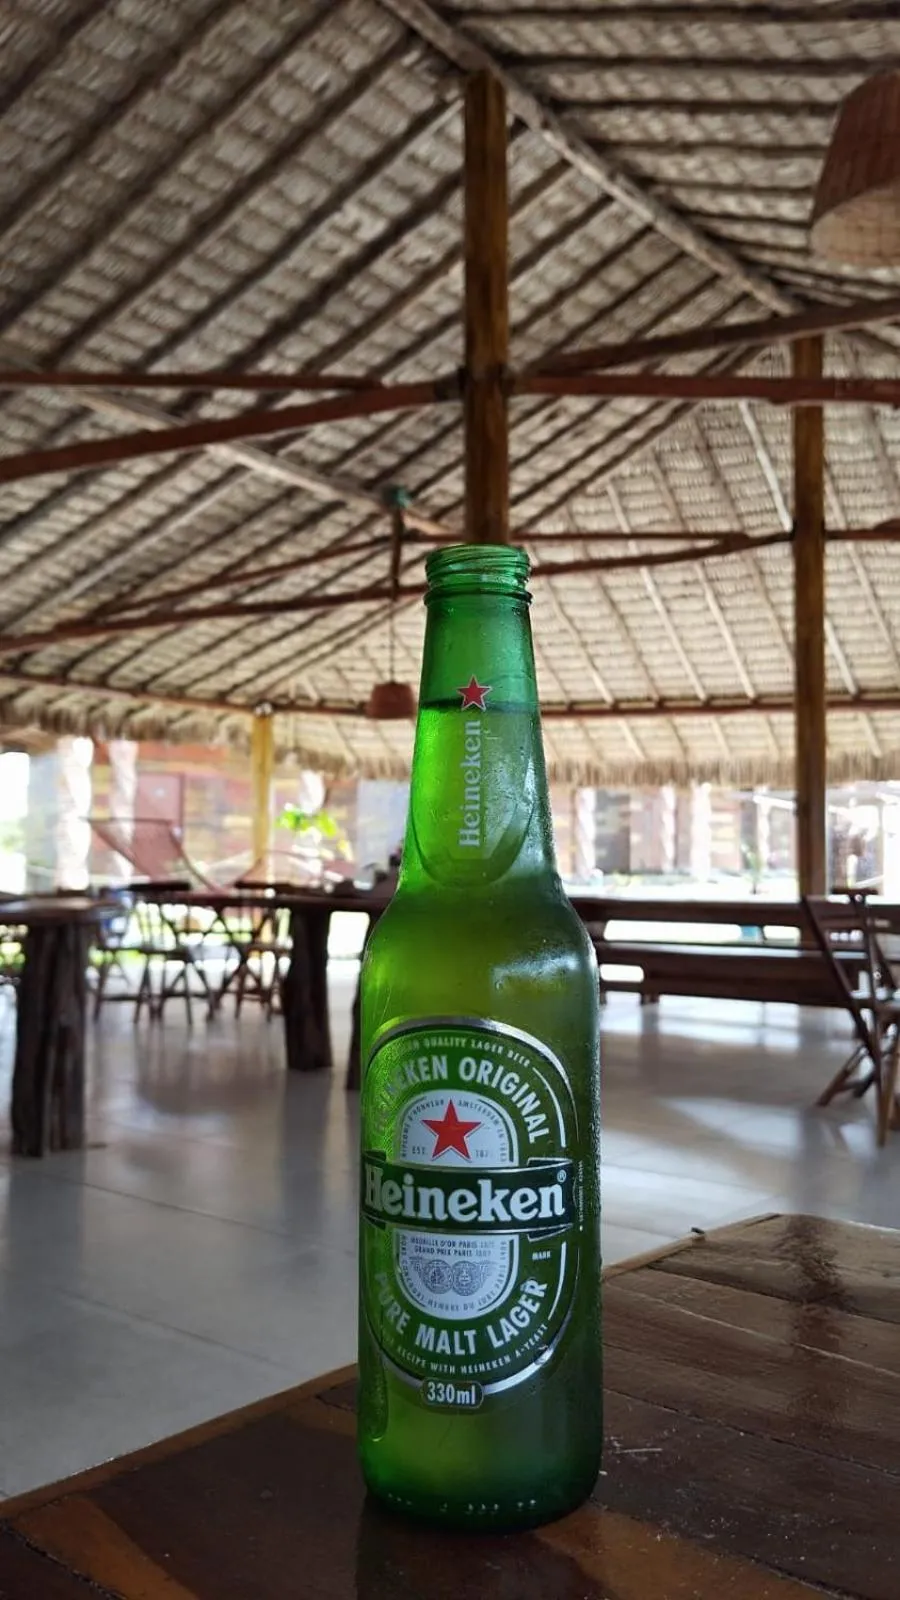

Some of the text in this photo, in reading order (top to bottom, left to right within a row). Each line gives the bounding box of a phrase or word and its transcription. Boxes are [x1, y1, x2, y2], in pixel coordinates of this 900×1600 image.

[459, 719, 481, 847] Heineken
[423, 1036, 466, 1048] QUALITY
[471, 1040, 504, 1055] LAGER
[459, 1056, 550, 1144] ORIGINAL
[374, 1271, 548, 1356] PURE MALT LAGER
[430, 1361, 456, 1374] WITH
[460, 1354, 511, 1375] HEINEKEN
[426, 1381, 477, 1406] 330ml
